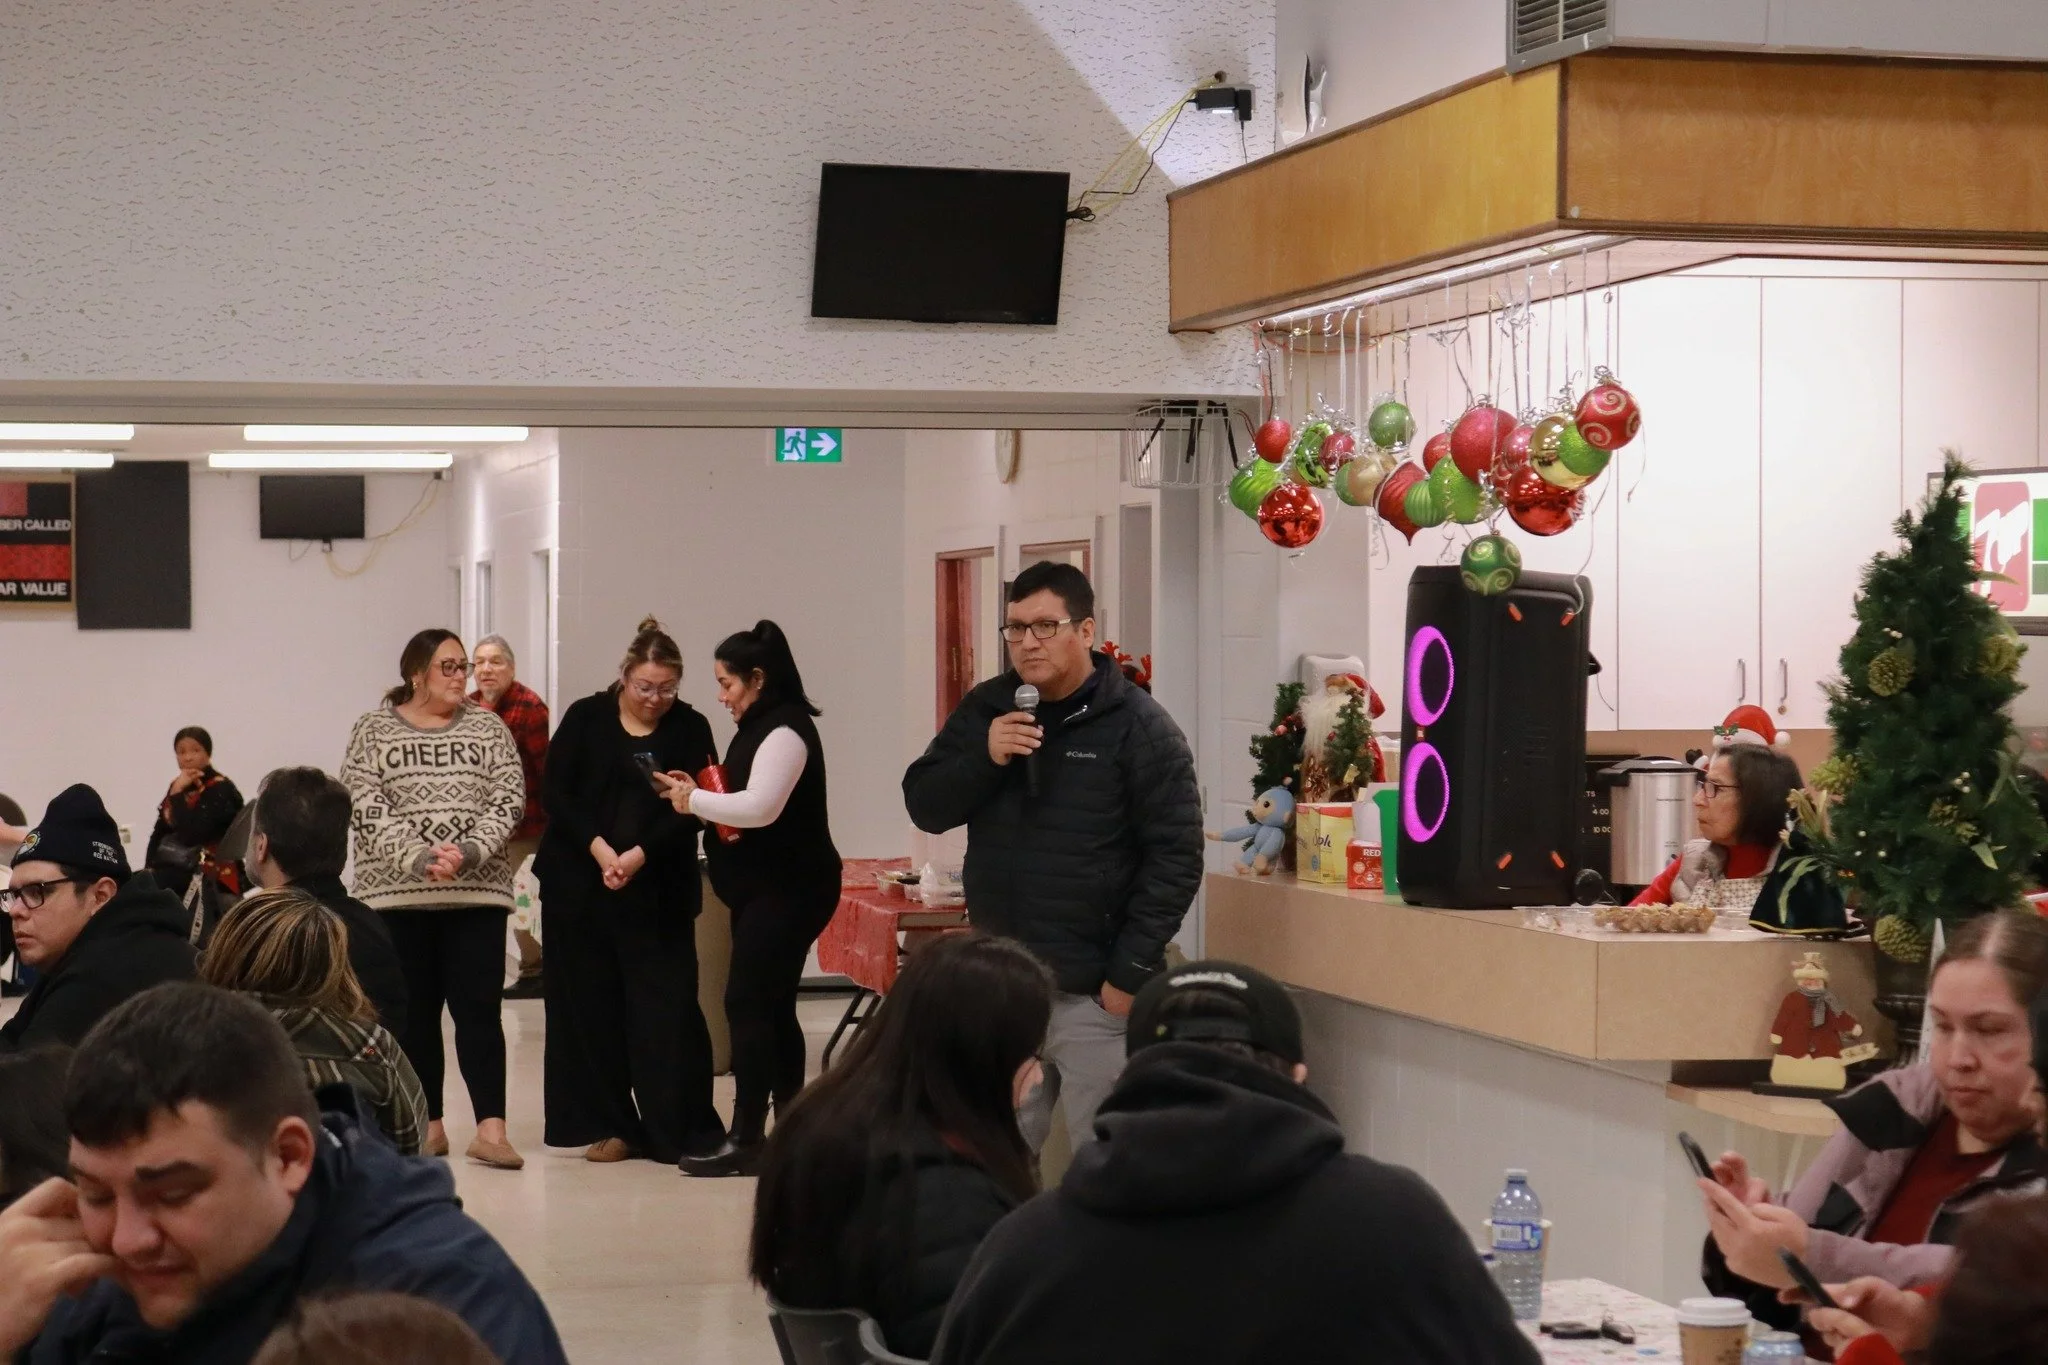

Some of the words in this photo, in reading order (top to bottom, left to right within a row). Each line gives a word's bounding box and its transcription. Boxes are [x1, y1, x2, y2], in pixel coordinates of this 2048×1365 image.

[24, 519, 71, 531] CALLED
[20, 582, 67, 596] VALUE
[386, 741, 486, 769] CHEERS!
[1363, 848, 1382, 857] RED
